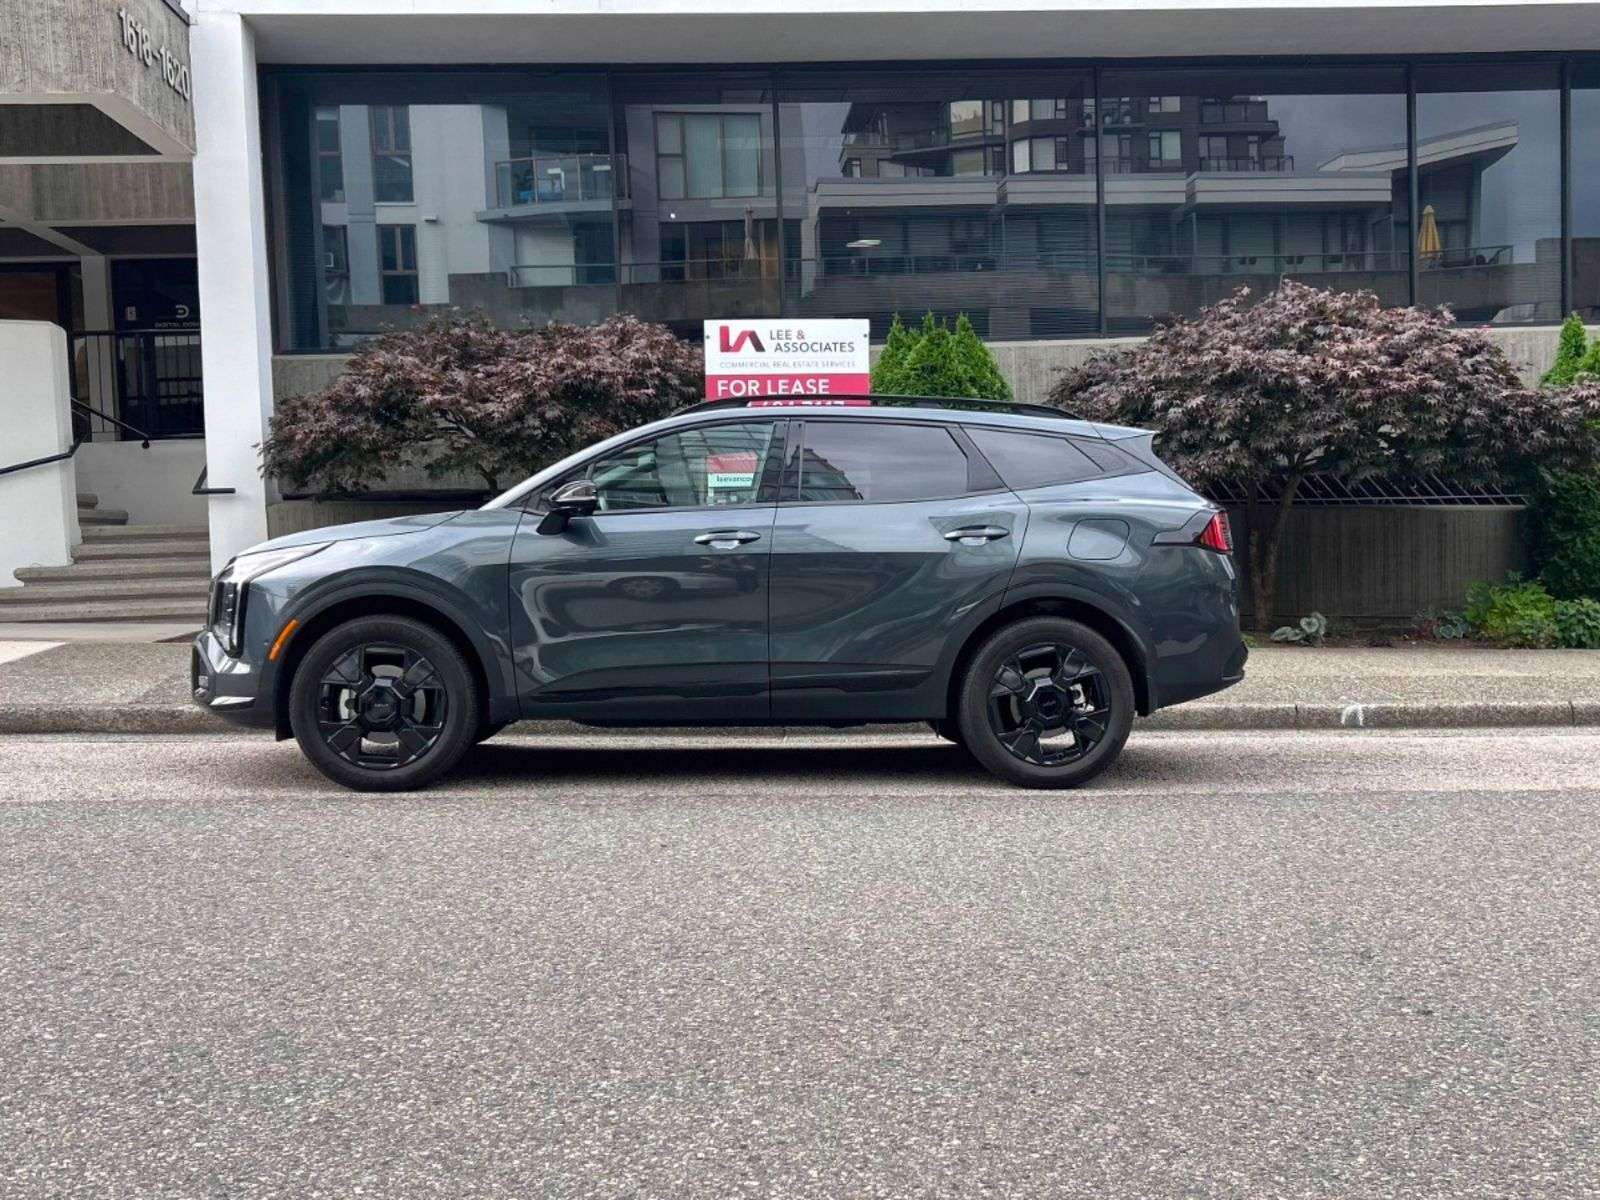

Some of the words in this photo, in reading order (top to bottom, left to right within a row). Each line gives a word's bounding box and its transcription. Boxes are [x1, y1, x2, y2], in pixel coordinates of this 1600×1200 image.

[117, 8, 190, 101] 1618-1620
[770, 329, 792, 341] LEE
[796, 329, 805, 340] &
[774, 341, 855, 353] ASSOCIATES
[719, 361, 770, 369] COMMERCIAL
[772, 361, 791, 369] REAL
[792, 361, 820, 369] ESTATE
[717, 379, 760, 397] FOR
[767, 378, 830, 395] LEASE
